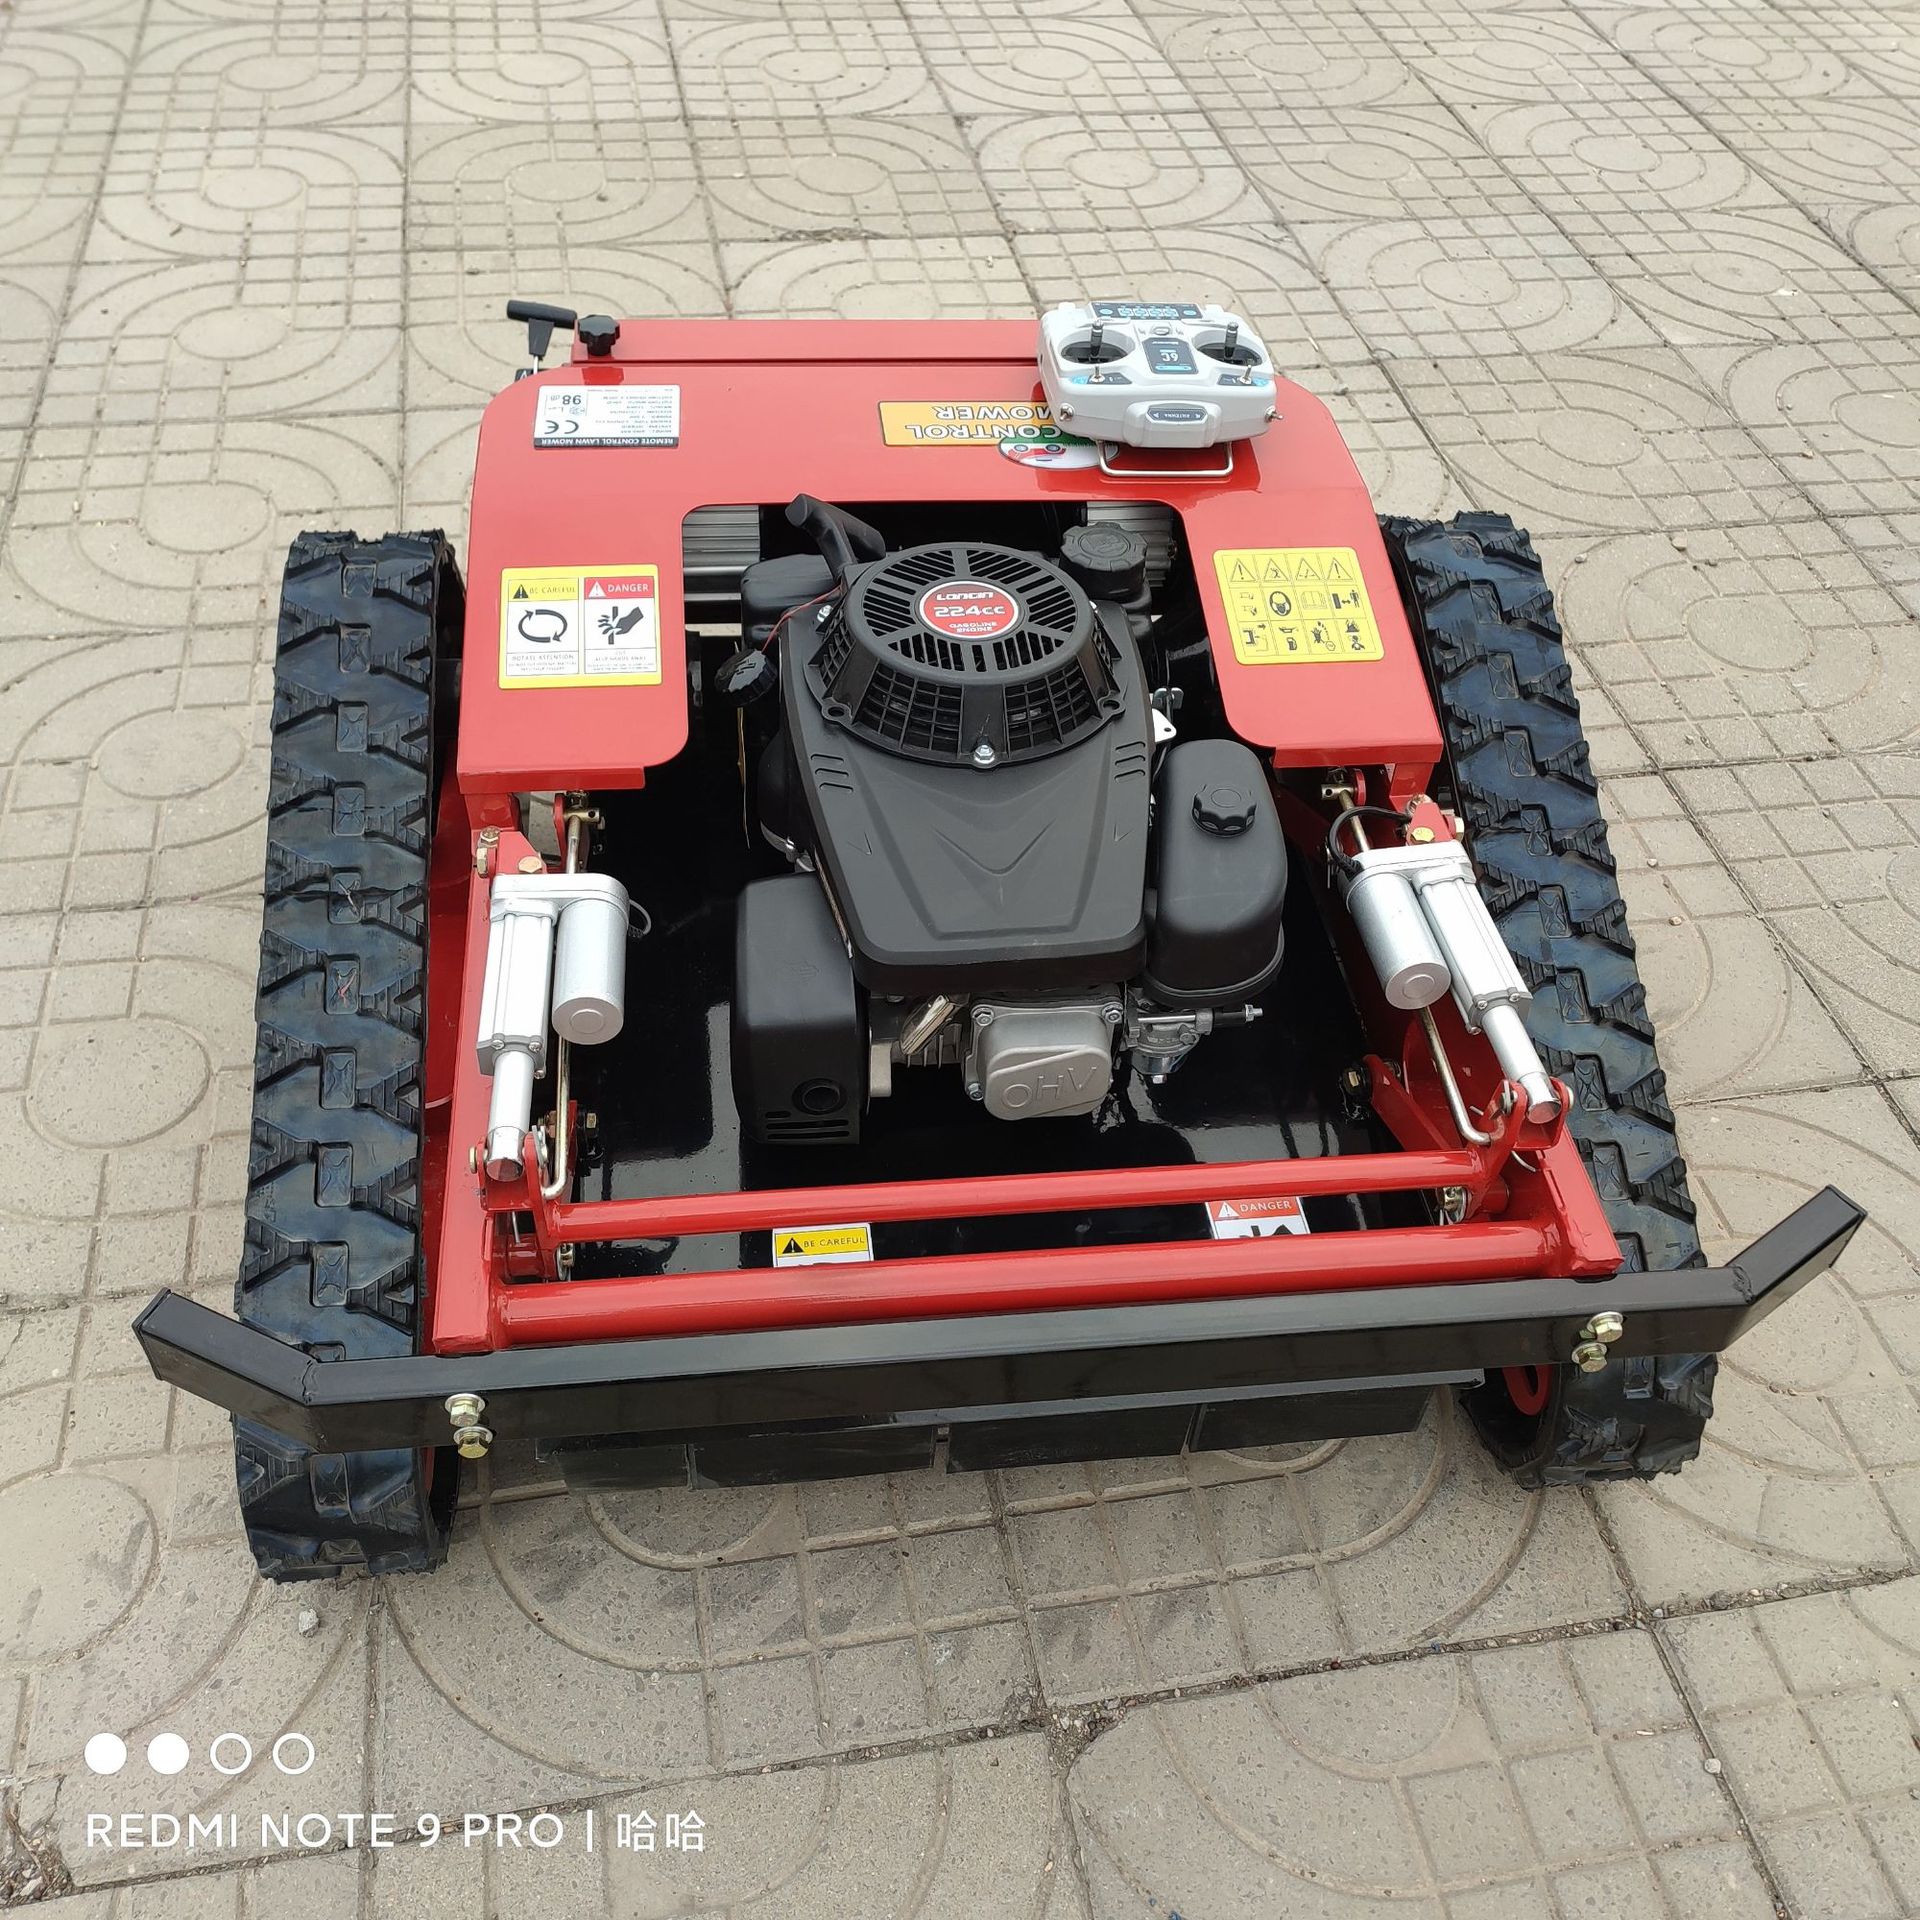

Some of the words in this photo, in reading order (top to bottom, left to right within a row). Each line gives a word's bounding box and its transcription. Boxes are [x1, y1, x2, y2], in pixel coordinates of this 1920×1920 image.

[562, 394, 582, 405] 98
[905, 424, 1063, 439] CONTROL
[541, 437, 574, 445] MOWER
[575, 437, 601, 445] LAWN
[601, 437, 640, 445] CONTROL
[641, 437, 674, 445] REMOTE
[607, 583, 649, 593] DANGER
[1001, 1066, 1097, 1108] OHV
[1239, 1200, 1293, 1213] DANGER
[803, 1240, 816, 1248] BE
[819, 1236, 865, 1247] CAREFUL
